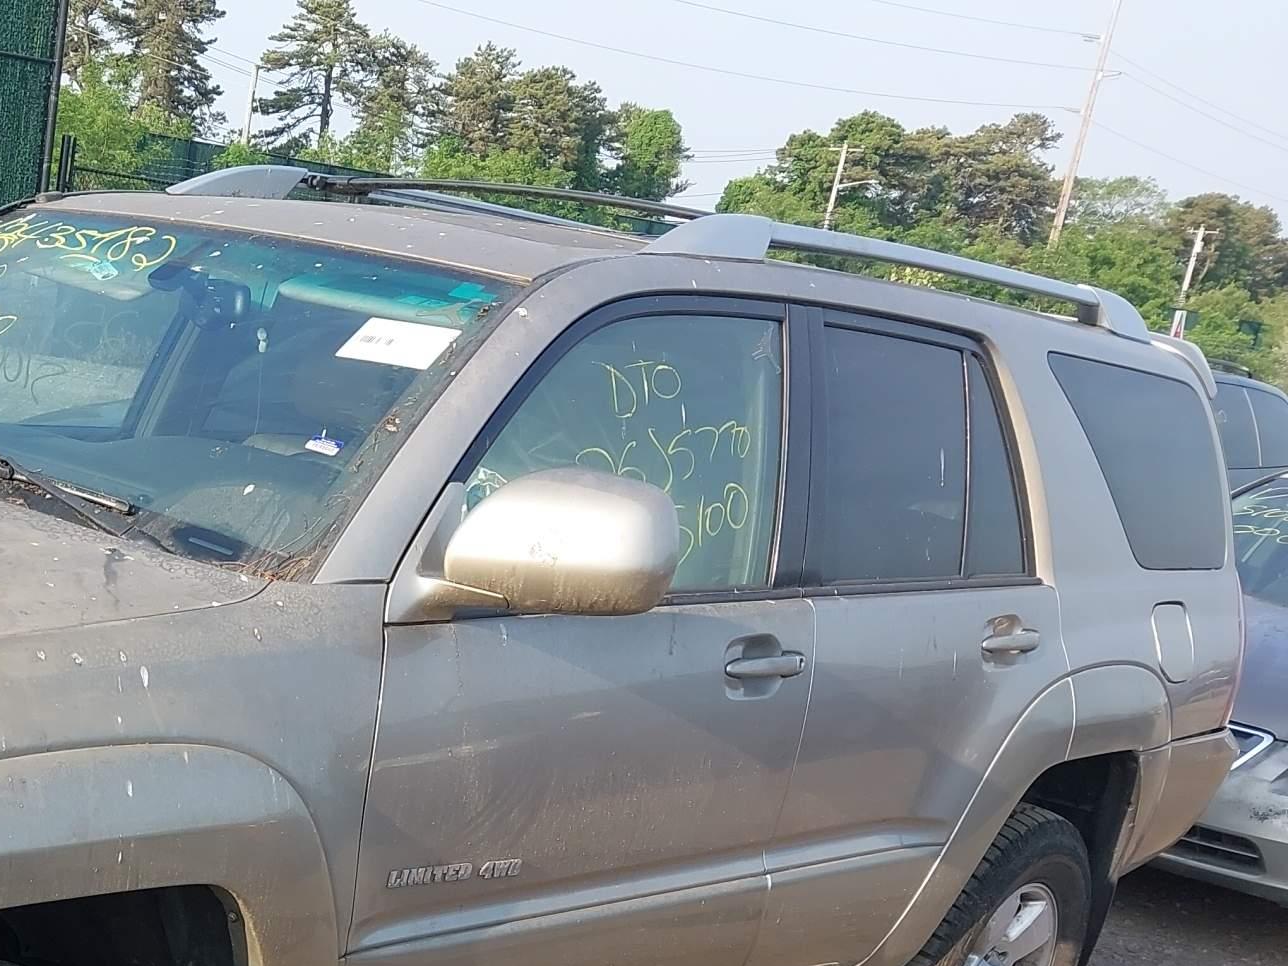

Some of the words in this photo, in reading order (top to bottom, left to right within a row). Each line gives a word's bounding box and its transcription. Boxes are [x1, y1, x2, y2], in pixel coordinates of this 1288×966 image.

[593, 359, 682, 418] DTO
[386, 862, 473, 889] LIMITED
[479, 858, 523, 880] 4WD
